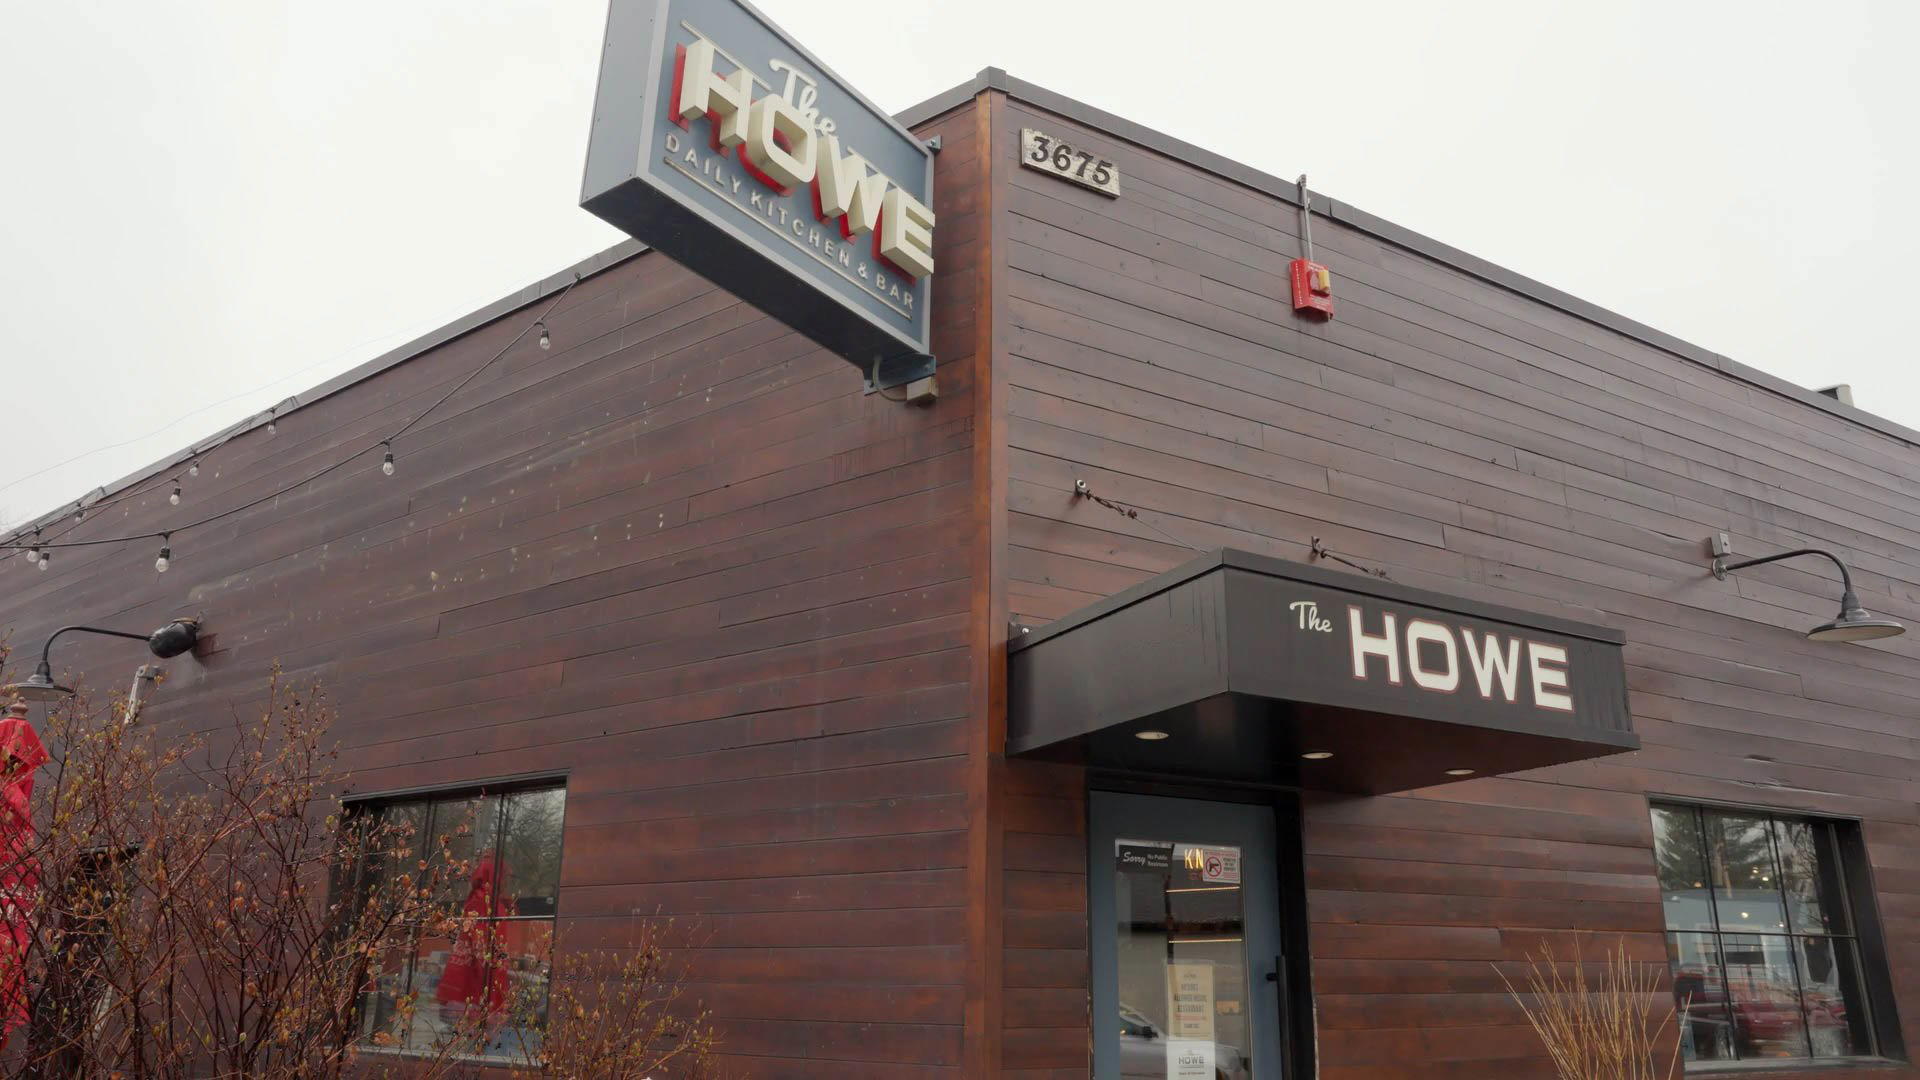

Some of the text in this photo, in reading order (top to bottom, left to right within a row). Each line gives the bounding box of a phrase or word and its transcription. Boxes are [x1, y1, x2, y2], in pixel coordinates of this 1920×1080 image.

[769, 58, 837, 137] The
[677, 37, 935, 280] HOWE
[1031, 136, 1113, 186] 3675
[665, 133, 914, 311] DAILY KITCHEN & BAR
[1289, 600, 1575, 713] The HOWE
[1123, 851, 1146, 867] Sorry
[1178, 1055, 1205, 1065] HOWE
